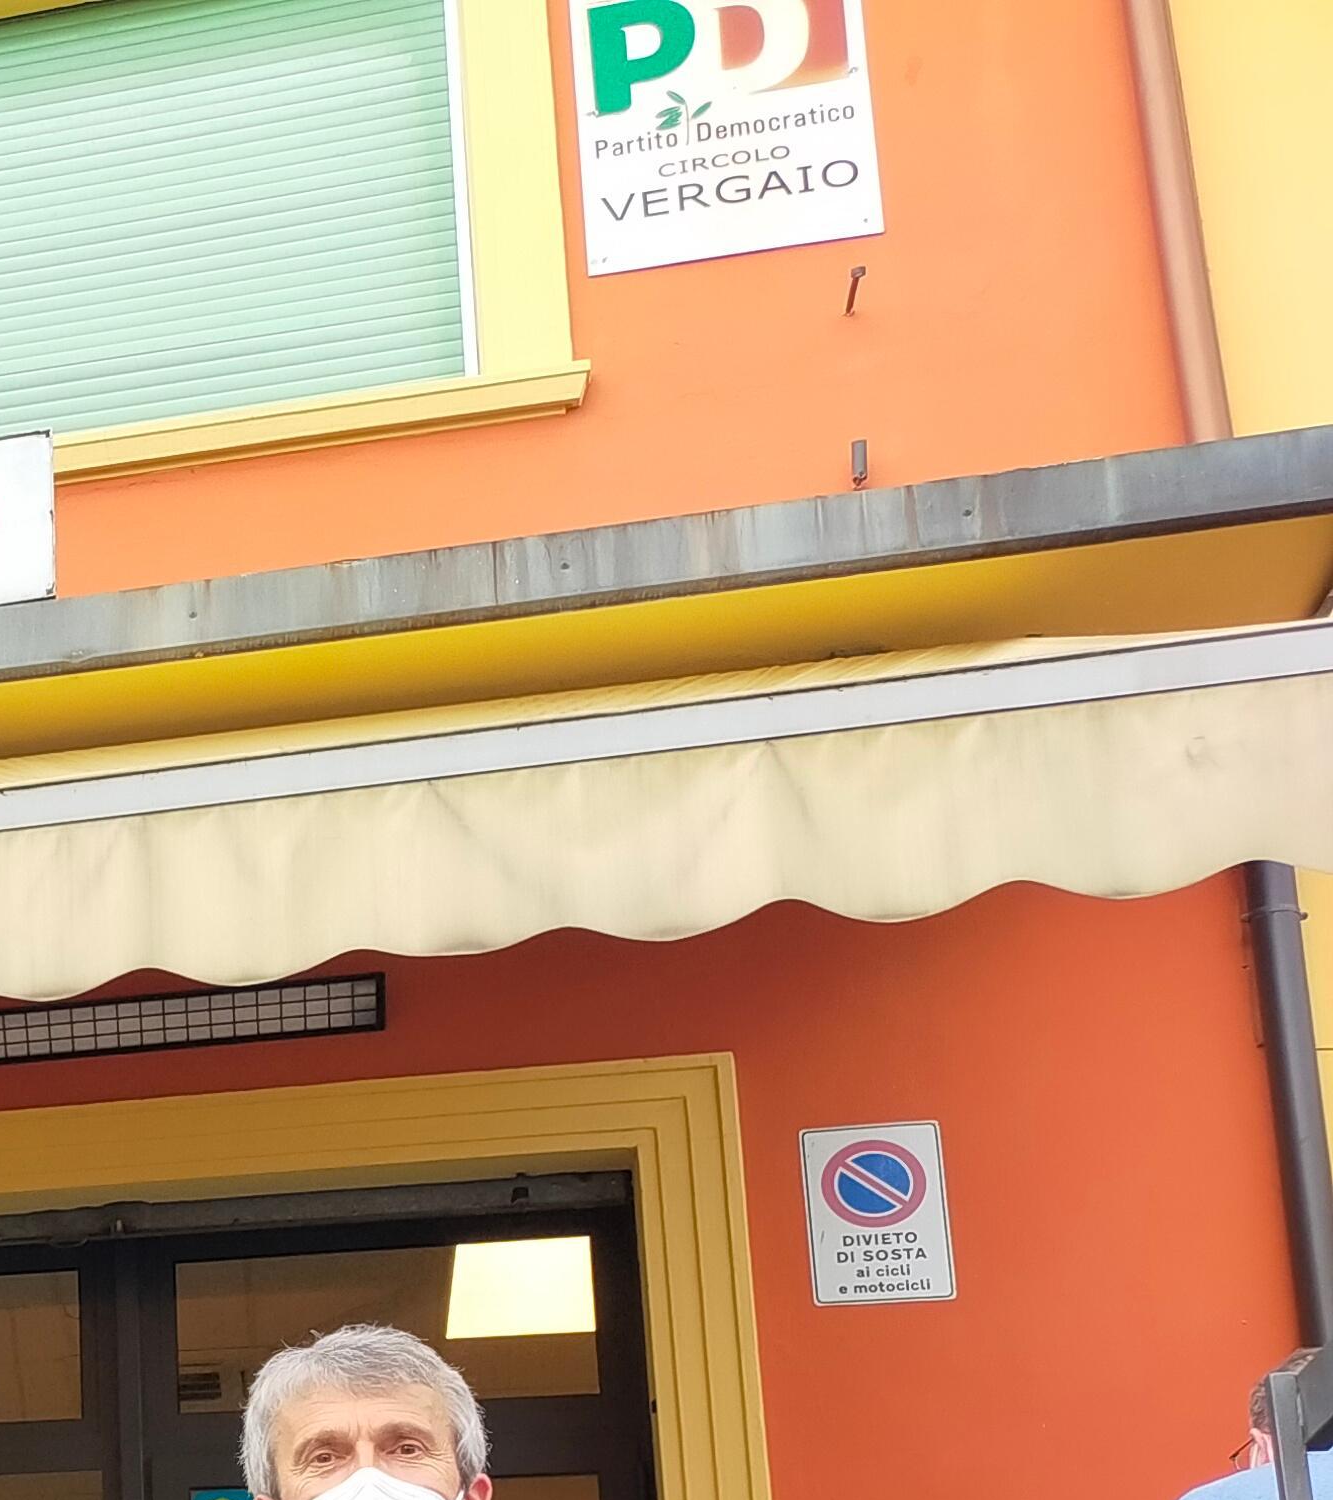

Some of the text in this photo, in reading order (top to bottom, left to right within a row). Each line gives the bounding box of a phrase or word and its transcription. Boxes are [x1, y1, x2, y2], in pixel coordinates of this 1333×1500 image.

[594, 103, 856, 159] Partito Democratico
[658, 145, 791, 177] CIRCOLO
[600, 159, 860, 222] VERGAIO
[842, 1231, 918, 1247] DIVIETO
[836, 1248, 927, 1264] DI SOSTA
[856, 1264, 911, 1278] ai cicli
[839, 1279, 931, 1294] e motocicli
